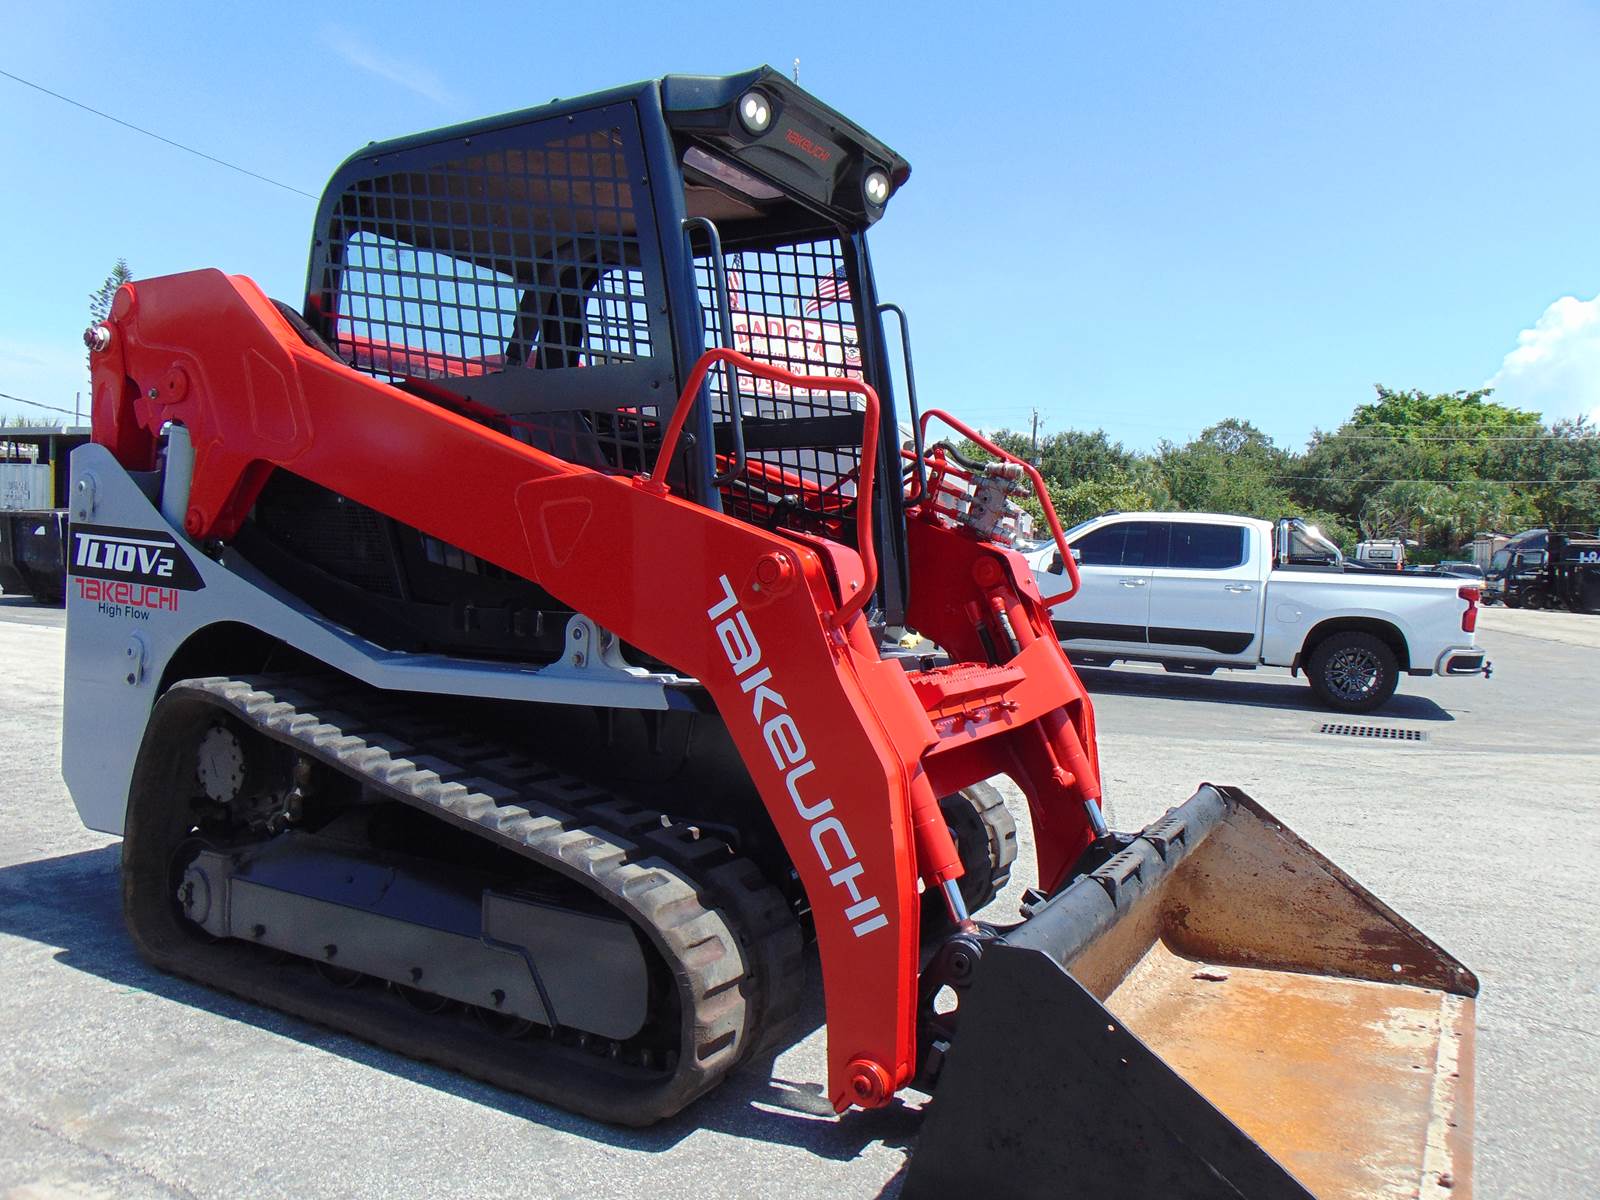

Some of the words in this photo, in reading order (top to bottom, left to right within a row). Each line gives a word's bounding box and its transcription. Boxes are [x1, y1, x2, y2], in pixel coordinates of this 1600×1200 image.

[75, 533, 175, 577] TL10V2
[98, 603, 122, 618] High
[124, 606, 150, 620] Flow
